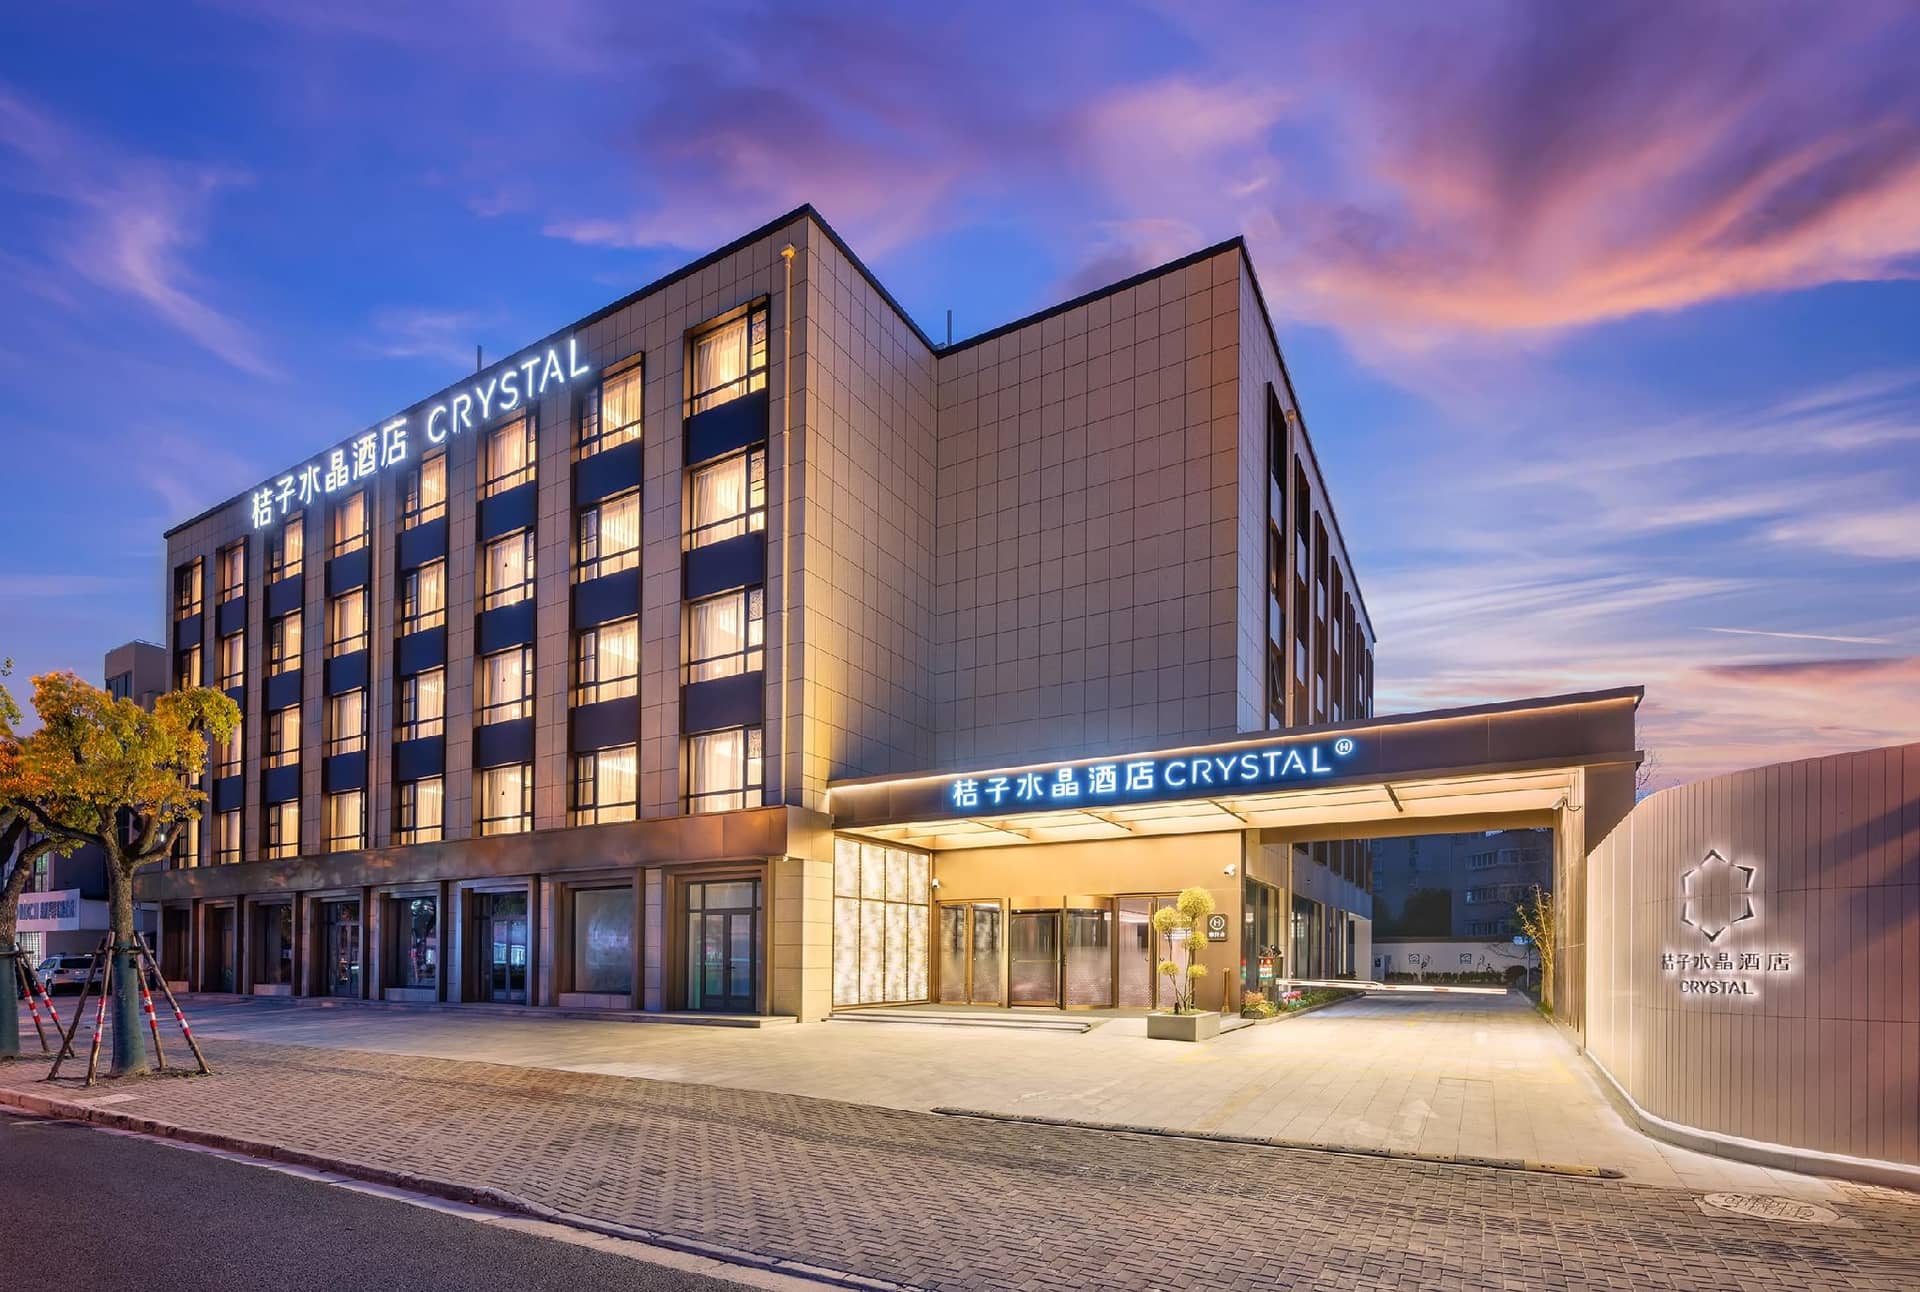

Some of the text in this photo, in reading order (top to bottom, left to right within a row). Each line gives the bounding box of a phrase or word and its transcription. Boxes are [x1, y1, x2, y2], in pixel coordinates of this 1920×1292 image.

[252, 339, 590, 528] 桔子水晶酒店 CRYSTAL
[953, 761, 1155, 807] 桔子水晶酒店
[1165, 747, 1331, 786] CRYSTAL
[1662, 952, 1790, 971] 桔子水晶酒店
[1680, 980, 1754, 995] CRYSTAL
